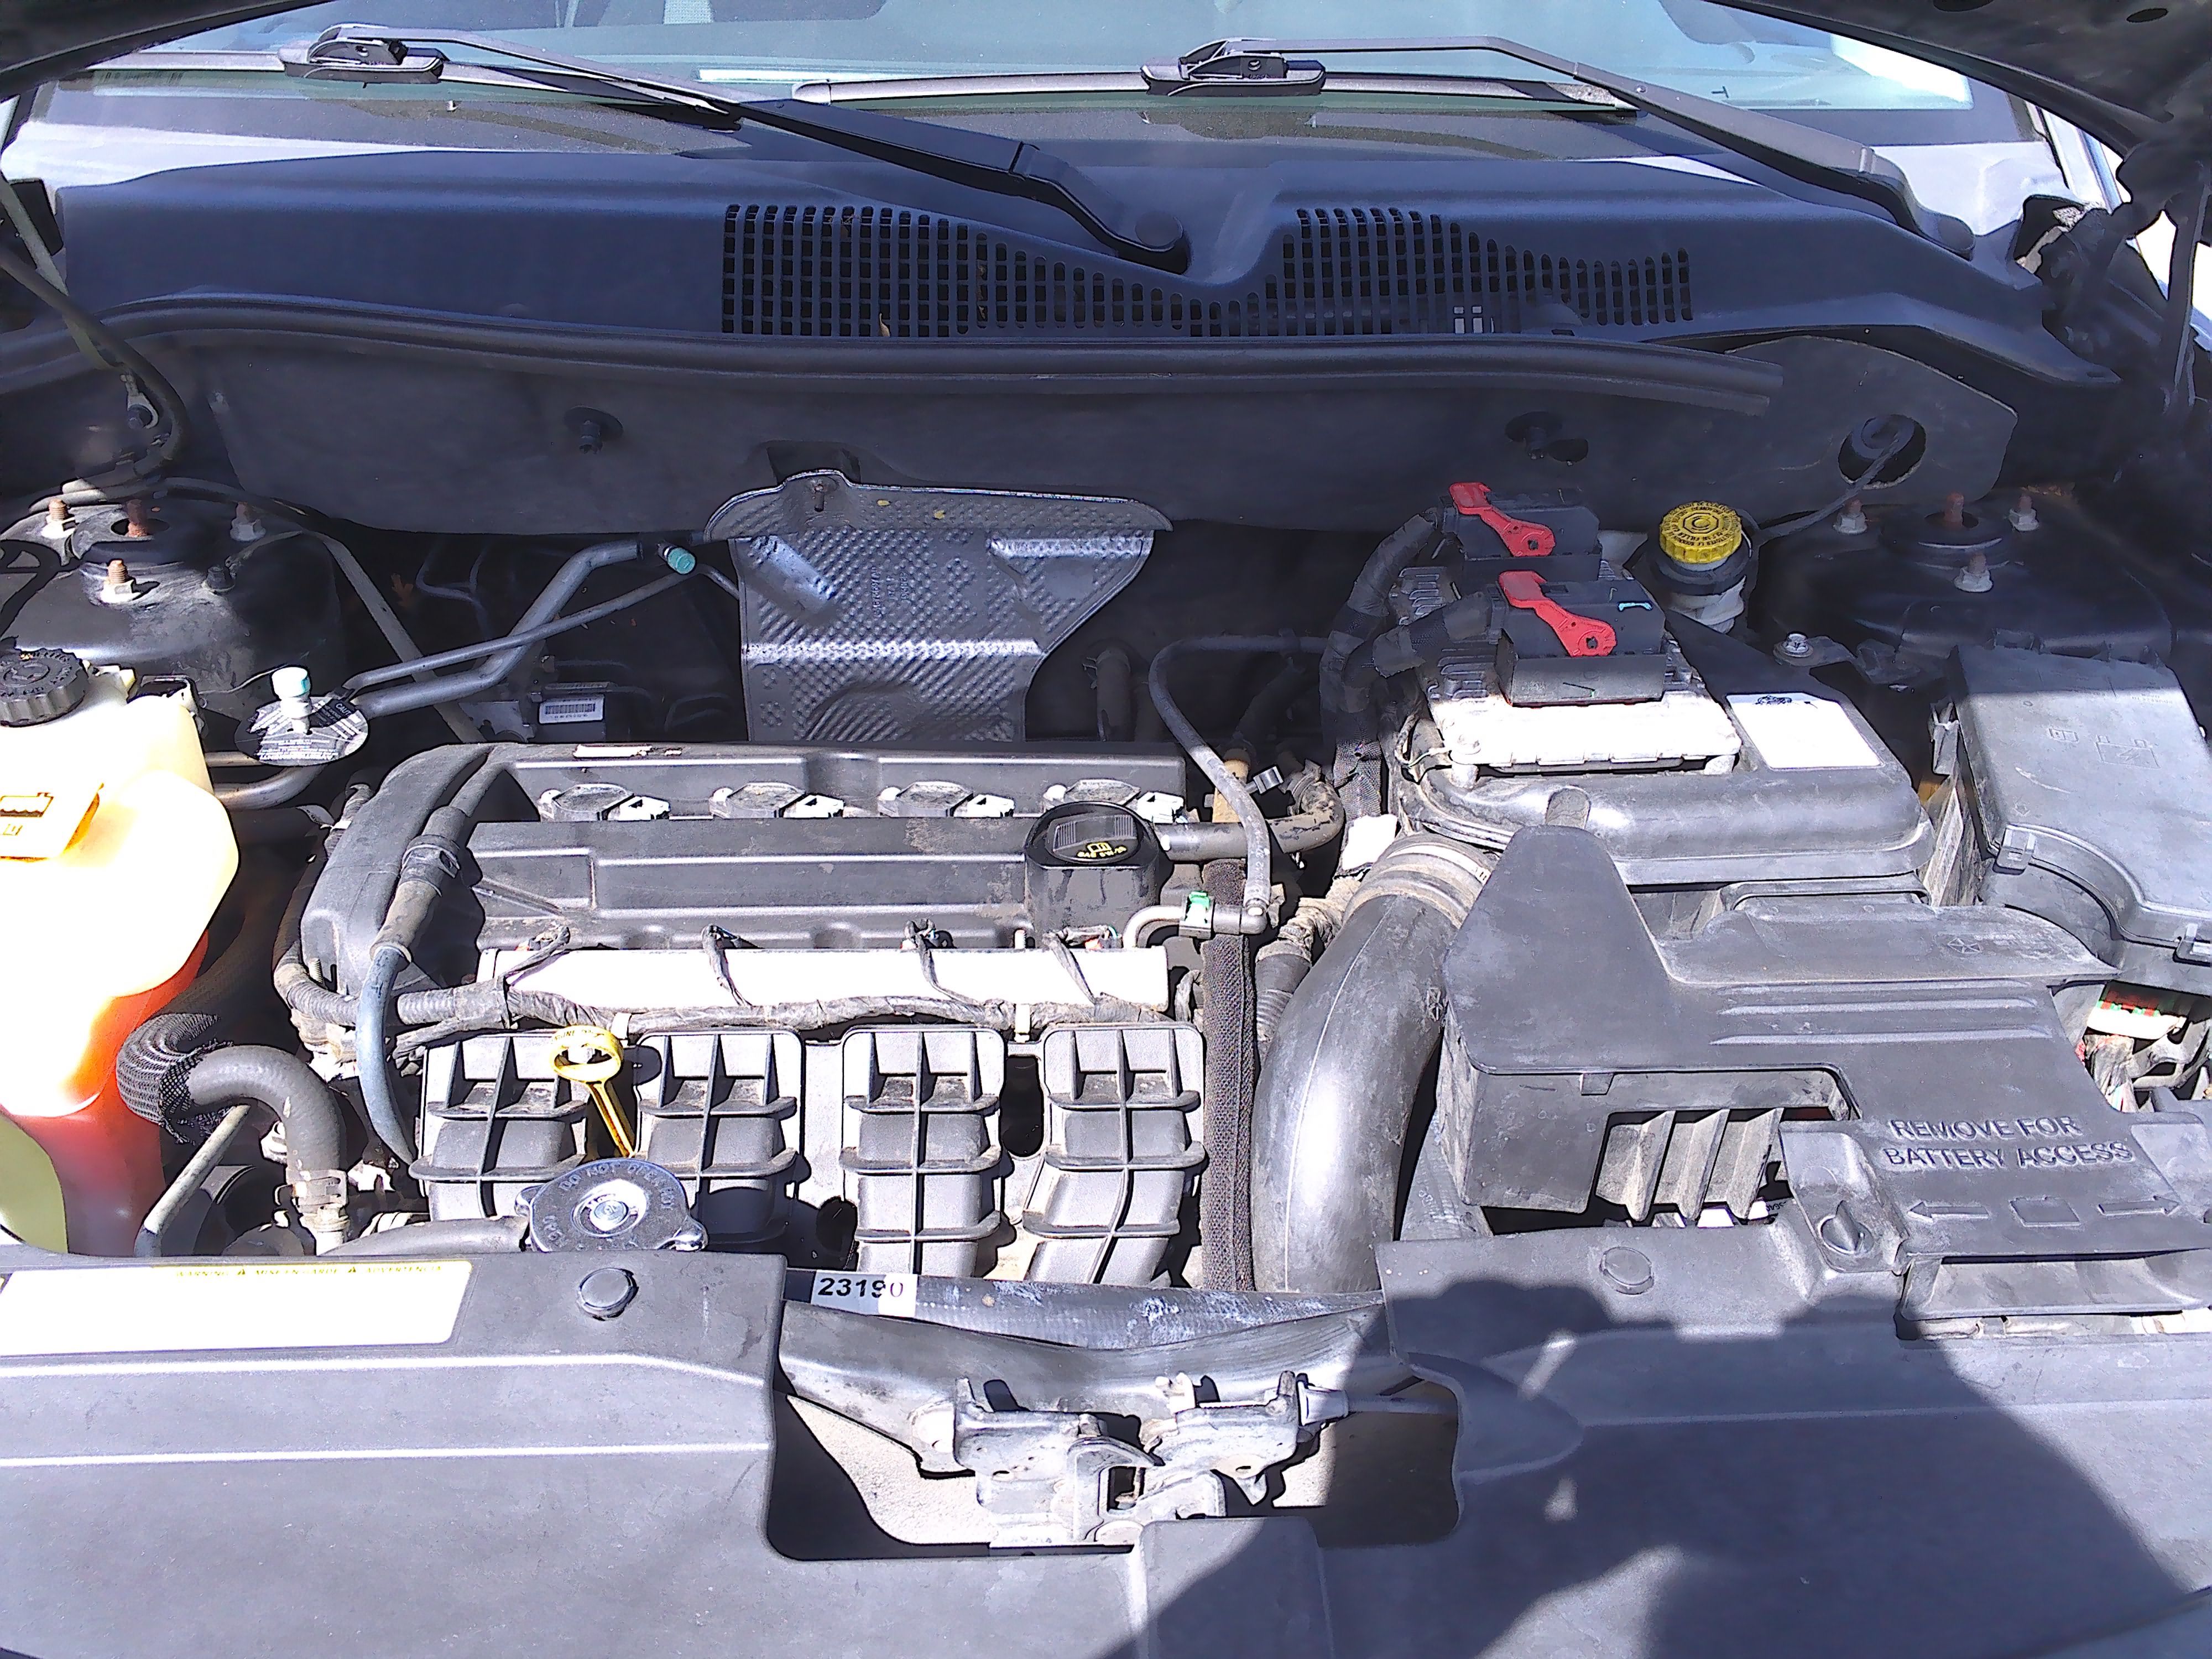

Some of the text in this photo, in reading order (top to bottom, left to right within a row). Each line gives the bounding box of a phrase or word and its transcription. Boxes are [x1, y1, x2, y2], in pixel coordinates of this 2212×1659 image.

[1888, 1114, 2084, 1142] REMOVE FOR
[1882, 1140, 2136, 1170] BATTERY ACCESS
[818, 1277, 904, 1298] 23190
